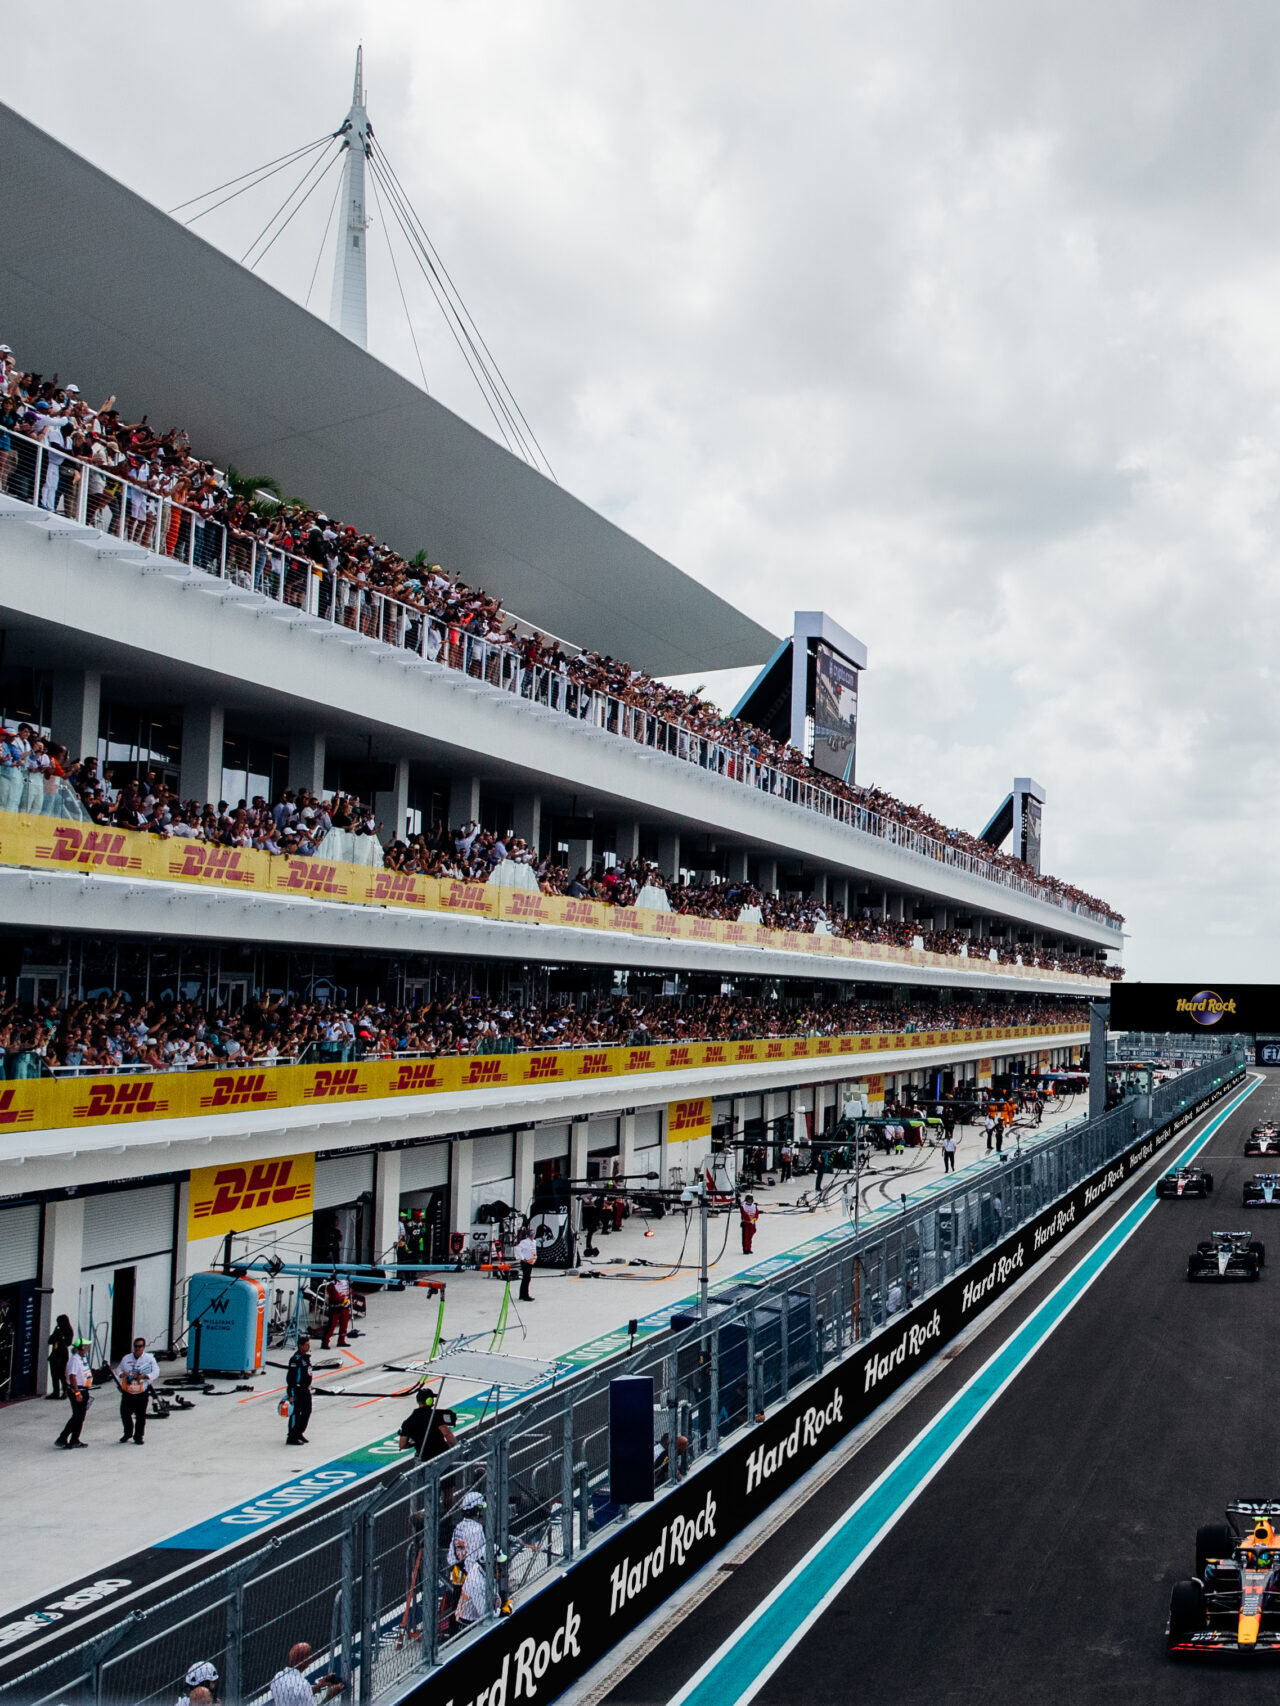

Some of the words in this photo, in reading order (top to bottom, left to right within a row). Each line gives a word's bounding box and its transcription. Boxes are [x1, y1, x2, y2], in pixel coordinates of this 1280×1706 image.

[50, 826, 129, 868] DHL
[181, 844, 250, 881] DHL
[287, 860, 339, 894] DHL
[374, 873, 417, 902] DHL
[448, 883, 485, 911] DHL
[511, 893, 543, 918] DHL
[565, 901, 593, 924] DHL
[1176, 998, 1208, 1012] Hard
[1207, 998, 1236, 1014] Rock
[469, 1060, 502, 1083] DHL
[530, 1056, 558, 1078] DHL
[583, 1053, 608, 1074] DHL
[629, 1050, 651, 1070] DHL
[669, 1048, 690, 1066] DHL
[212, 1075, 267, 1107] DHL
[313, 1069, 360, 1097] DHL
[397, 1064, 437, 1090] DHL
[87, 1082, 157, 1117] DHL
[675, 1100, 705, 1130] DHL
[211, 1160, 297, 1215] DHL
[1085, 1175, 1108, 1207] Hard
[1107, 1163, 1124, 1188] Rock
[559, 1205, 568, 1213] 22
[1034, 1214, 1057, 1251] Hard
[1056, 1201, 1075, 1233] Rock
[961, 1262, 997, 1313] Hard
[997, 1242, 1024, 1283] Rock
[864, 1331, 908, 1393] Hard
[908, 1308, 941, 1355] Rock
[746, 1414, 803, 1495] Hard
[803, 1387, 843, 1447] Rock
[221, 1470, 358, 1525] aramco
[610, 1525, 668, 1617] Hard
[669, 1490, 717, 1566] Rock
[44, 1579, 132, 1610] 2030
[514, 1601, 581, 1699] Rock
